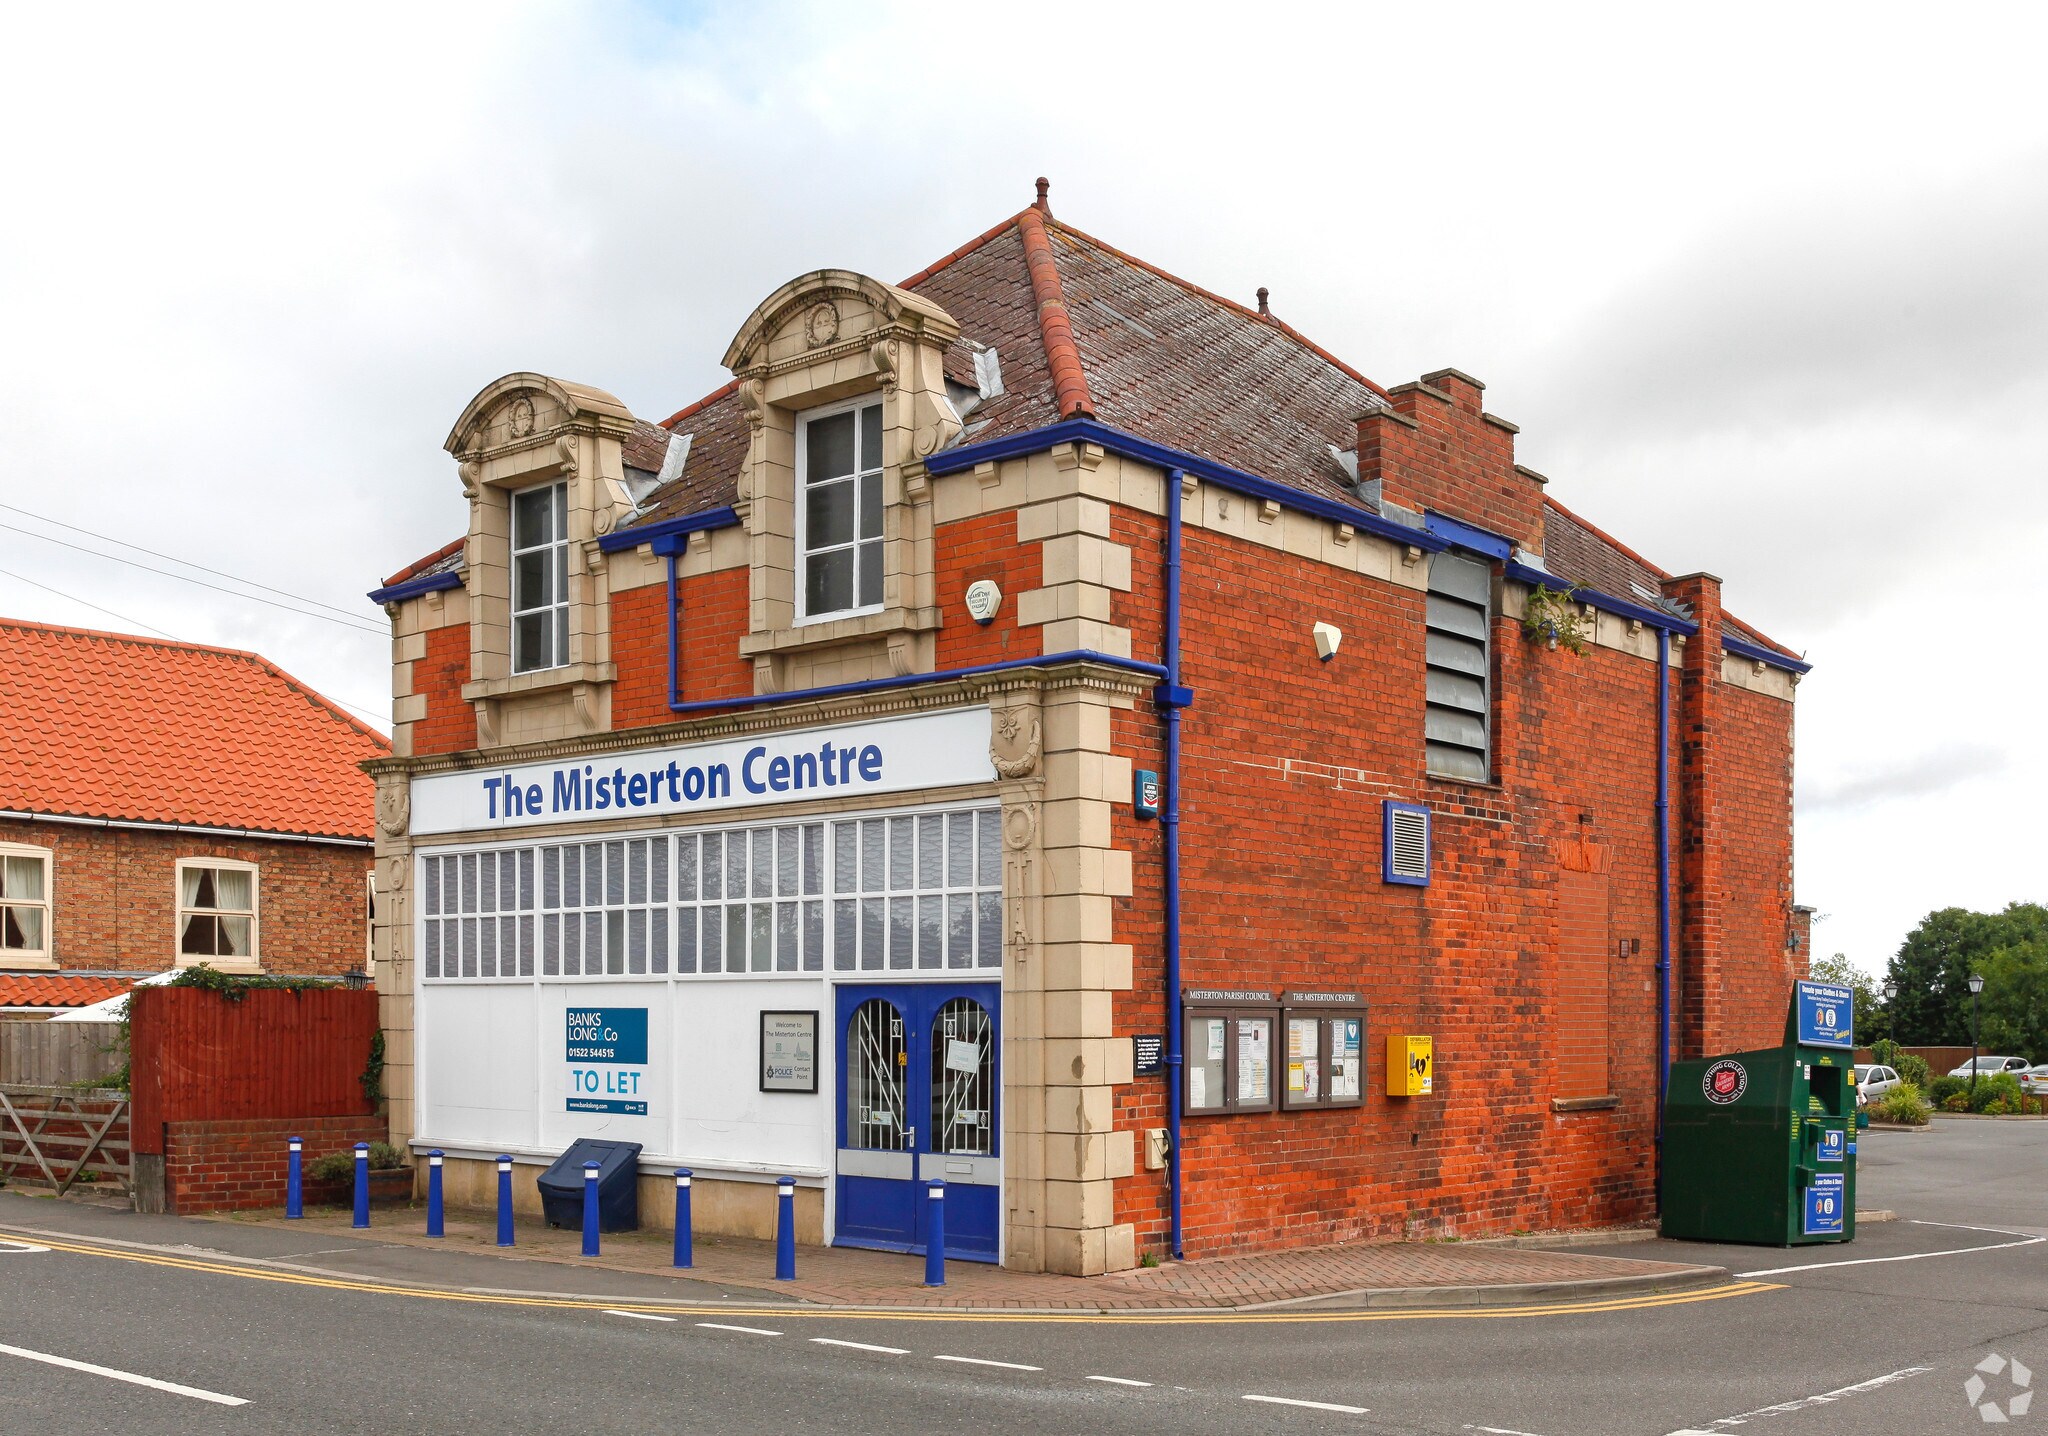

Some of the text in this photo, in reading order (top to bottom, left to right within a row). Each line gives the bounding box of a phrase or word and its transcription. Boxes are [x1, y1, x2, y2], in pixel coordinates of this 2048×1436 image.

[483, 741, 883, 819] The Misterton Centre
[1189, 991, 1271, 1000] MISTERTON PARISH COUNCIL
[1802, 985, 1814, 994] Donate
[1823, 988, 1835, 996] Clothes
[1304, 993, 1334, 1001] MISTERTON
[1335, 994, 1356, 1002] CENTRE
[568, 1012, 602, 1027] BANKS
[568, 1027, 618, 1042] LONG&Co
[568, 1048, 614, 1058] 01522 544515
[572, 1070, 641, 1094] TO LET
[1705, 1062, 1745, 1090] CLOTHING COLLECTION
[569, 1102, 608, 1111] www.bankslong.com
